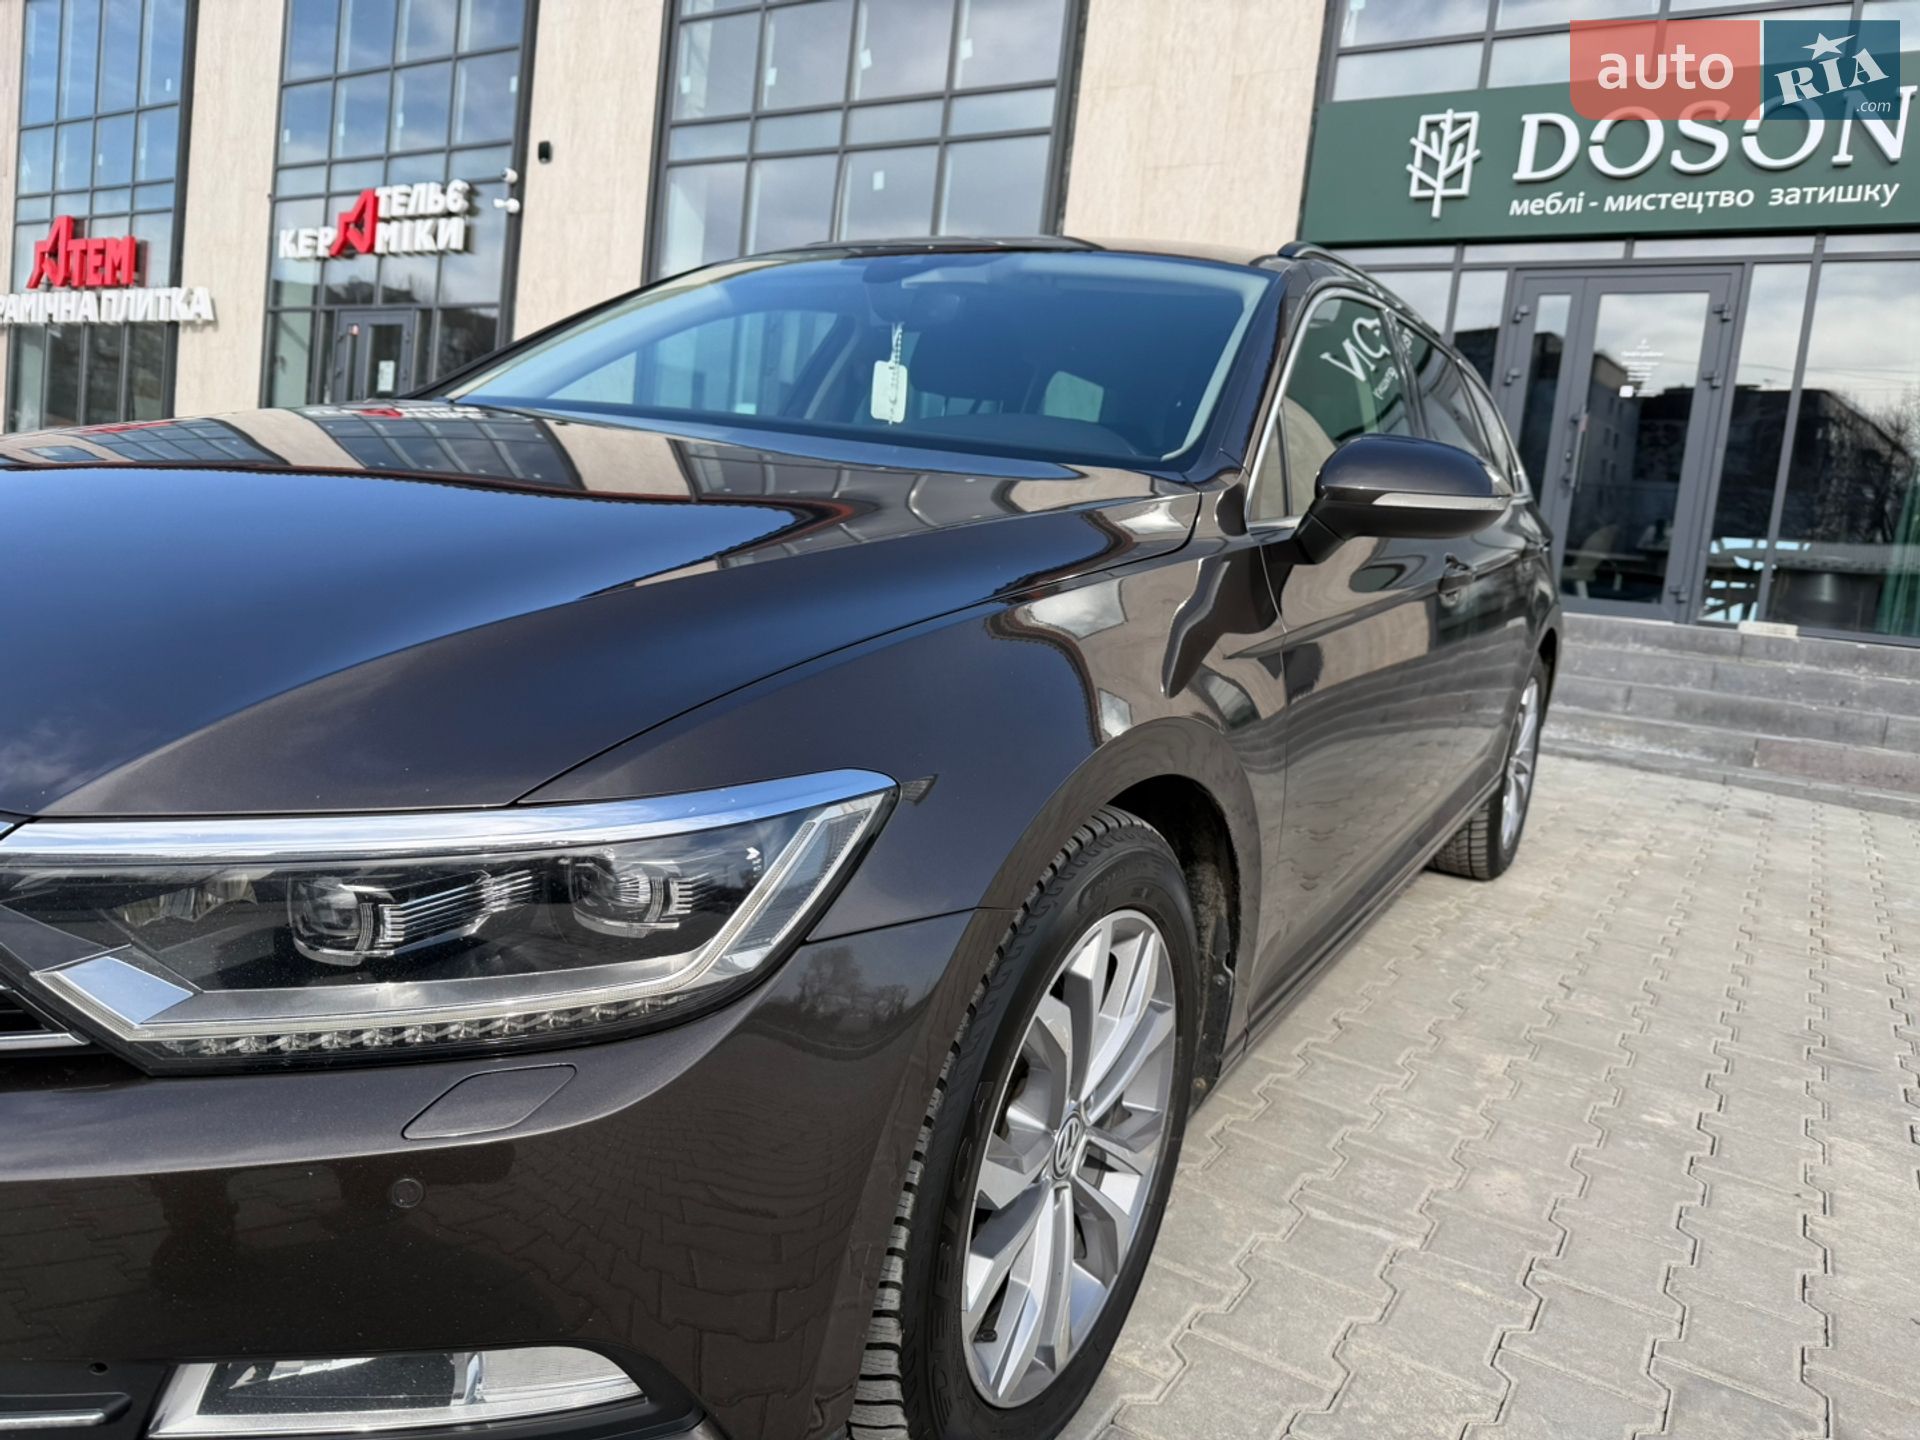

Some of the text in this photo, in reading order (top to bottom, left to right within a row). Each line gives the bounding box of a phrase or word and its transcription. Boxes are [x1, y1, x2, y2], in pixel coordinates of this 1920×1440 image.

[1513, 85, 1919, 184] DOSON
[1508, 192, 1584, 216] меблі
[1603, 188, 1755, 214] мистецтво
[1768, 182, 1900, 207] затишку
[27, 215, 137, 289] АТЕМ
[100, 286, 215, 322] ПЛИТКА
